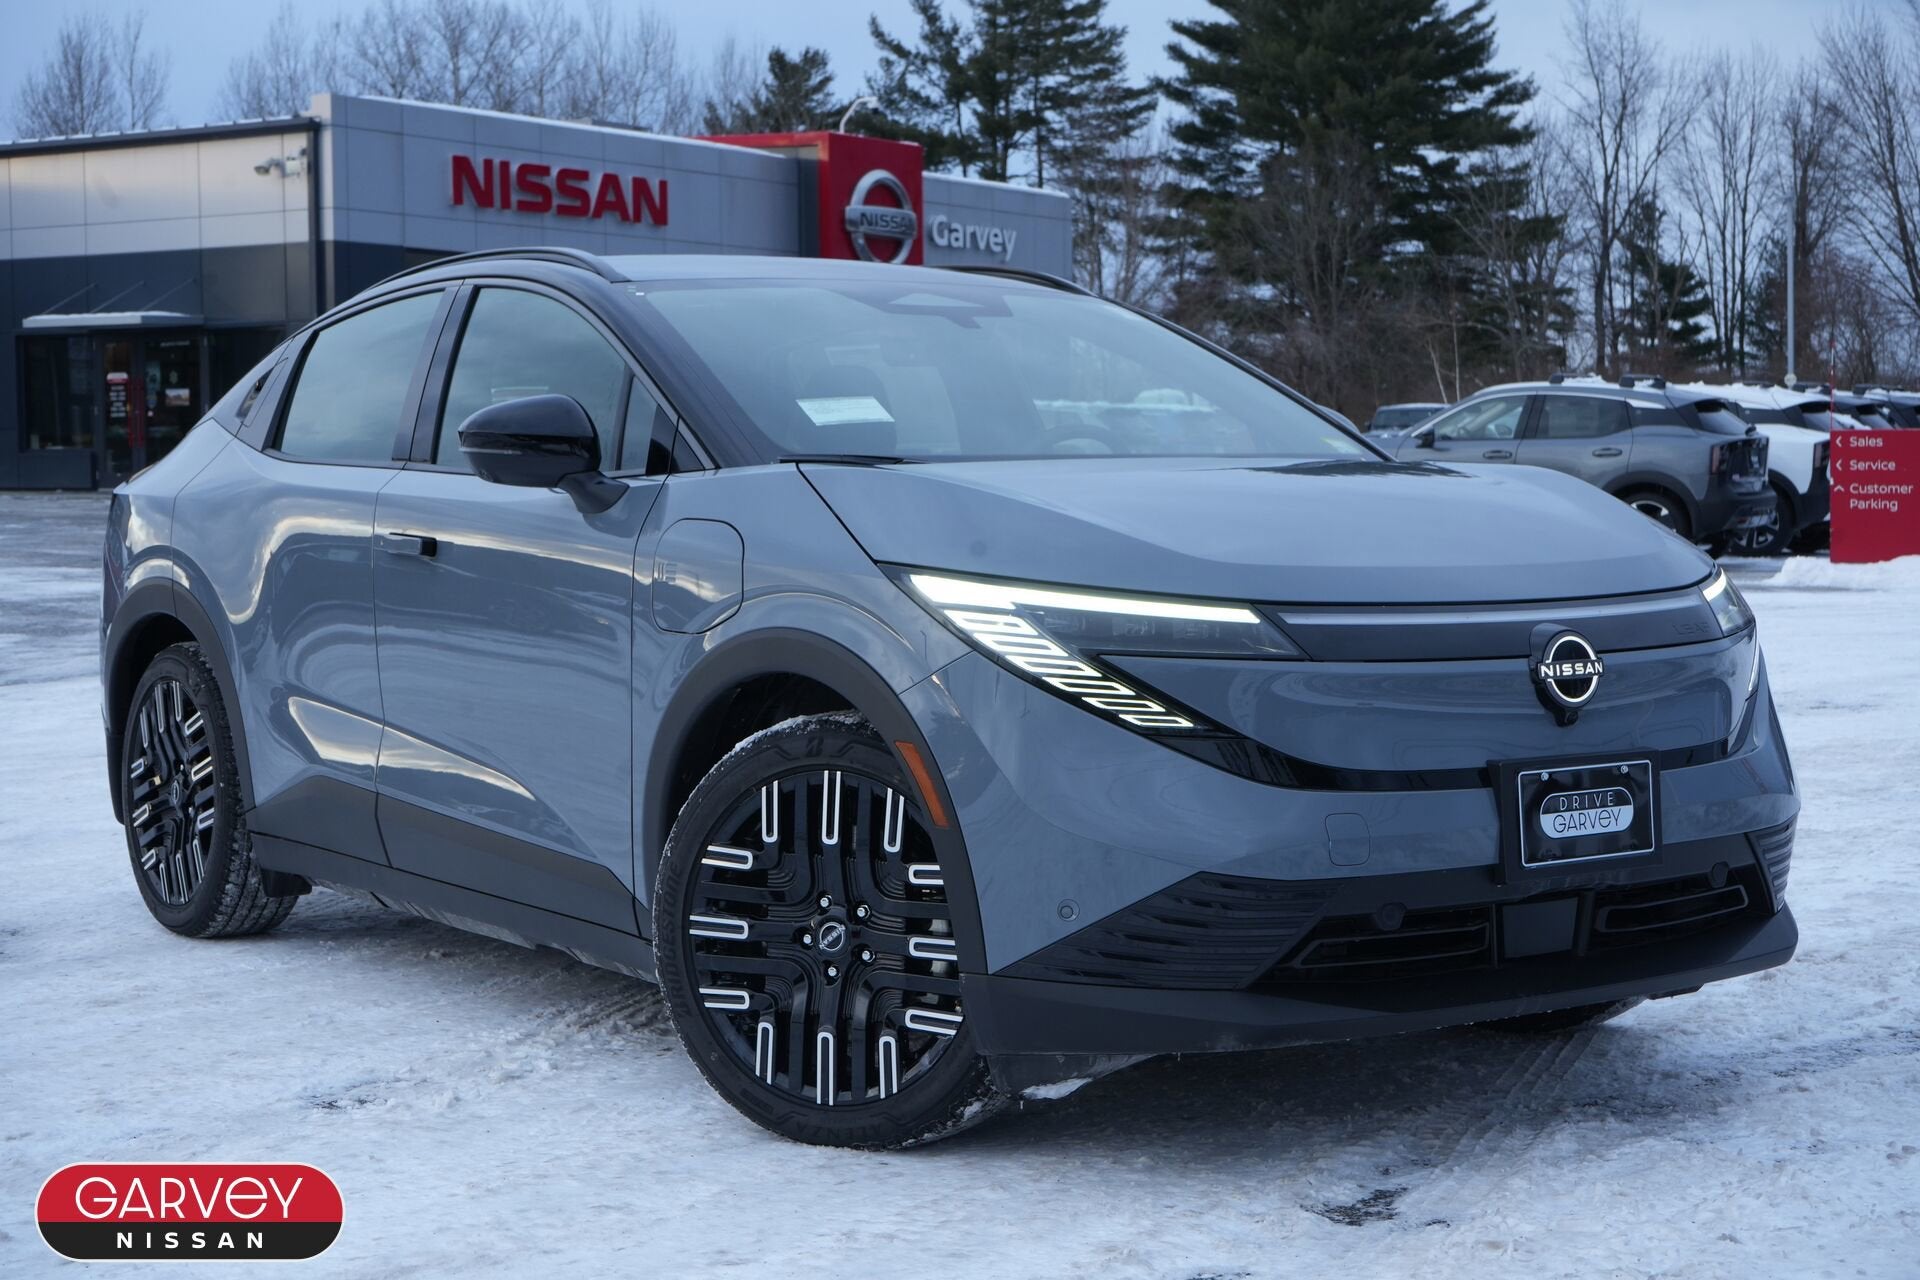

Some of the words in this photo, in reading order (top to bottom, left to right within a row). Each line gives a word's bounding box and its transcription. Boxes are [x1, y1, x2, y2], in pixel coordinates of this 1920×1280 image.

[452, 155, 669, 226] NISSAN
[931, 215, 1016, 262] Garvey
[1849, 436, 1883, 447] Sales
[1849, 459, 1896, 471] Service
[1849, 483, 1914, 494] Customer
[1849, 498, 1898, 511] Parking
[1540, 662, 1603, 677] NISSAN
[1559, 791, 1614, 811] DRIVE
